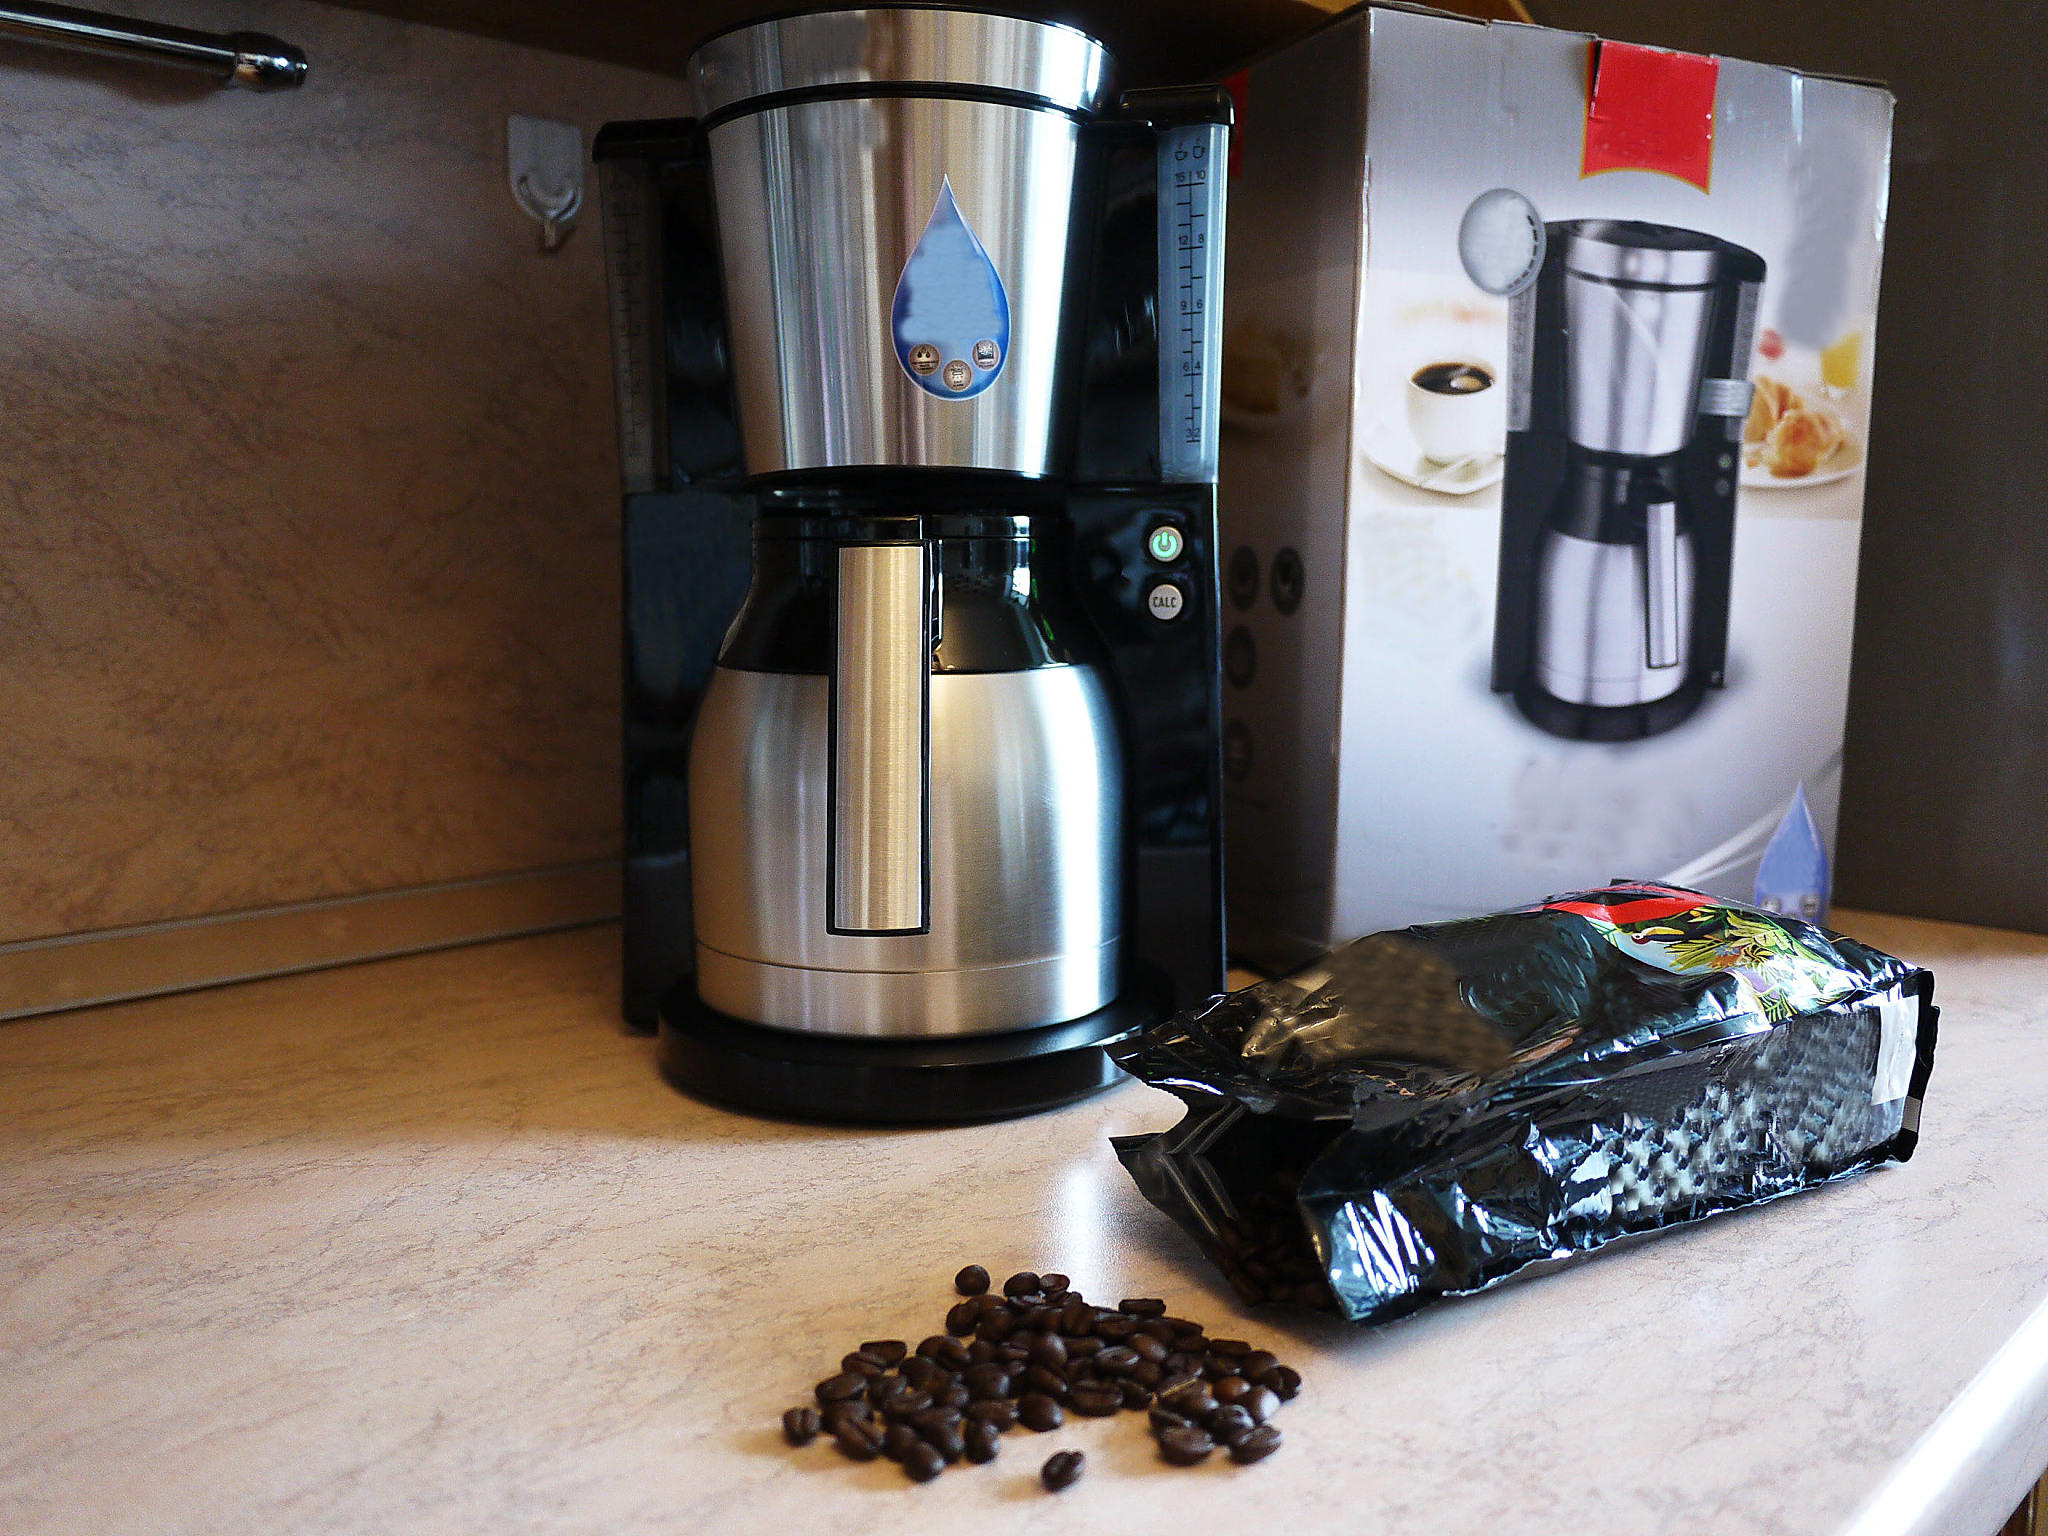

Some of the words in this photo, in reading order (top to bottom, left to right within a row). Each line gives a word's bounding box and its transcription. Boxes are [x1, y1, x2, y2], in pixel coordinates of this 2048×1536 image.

[1196, 169, 1206, 180] 10
[1178, 235, 1188, 246] 12
[1198, 233, 1205, 243] 8
[1180, 299, 1187, 310] 9
[1182, 361, 1189, 371] 6
[1152, 596, 1177, 609] CALC
